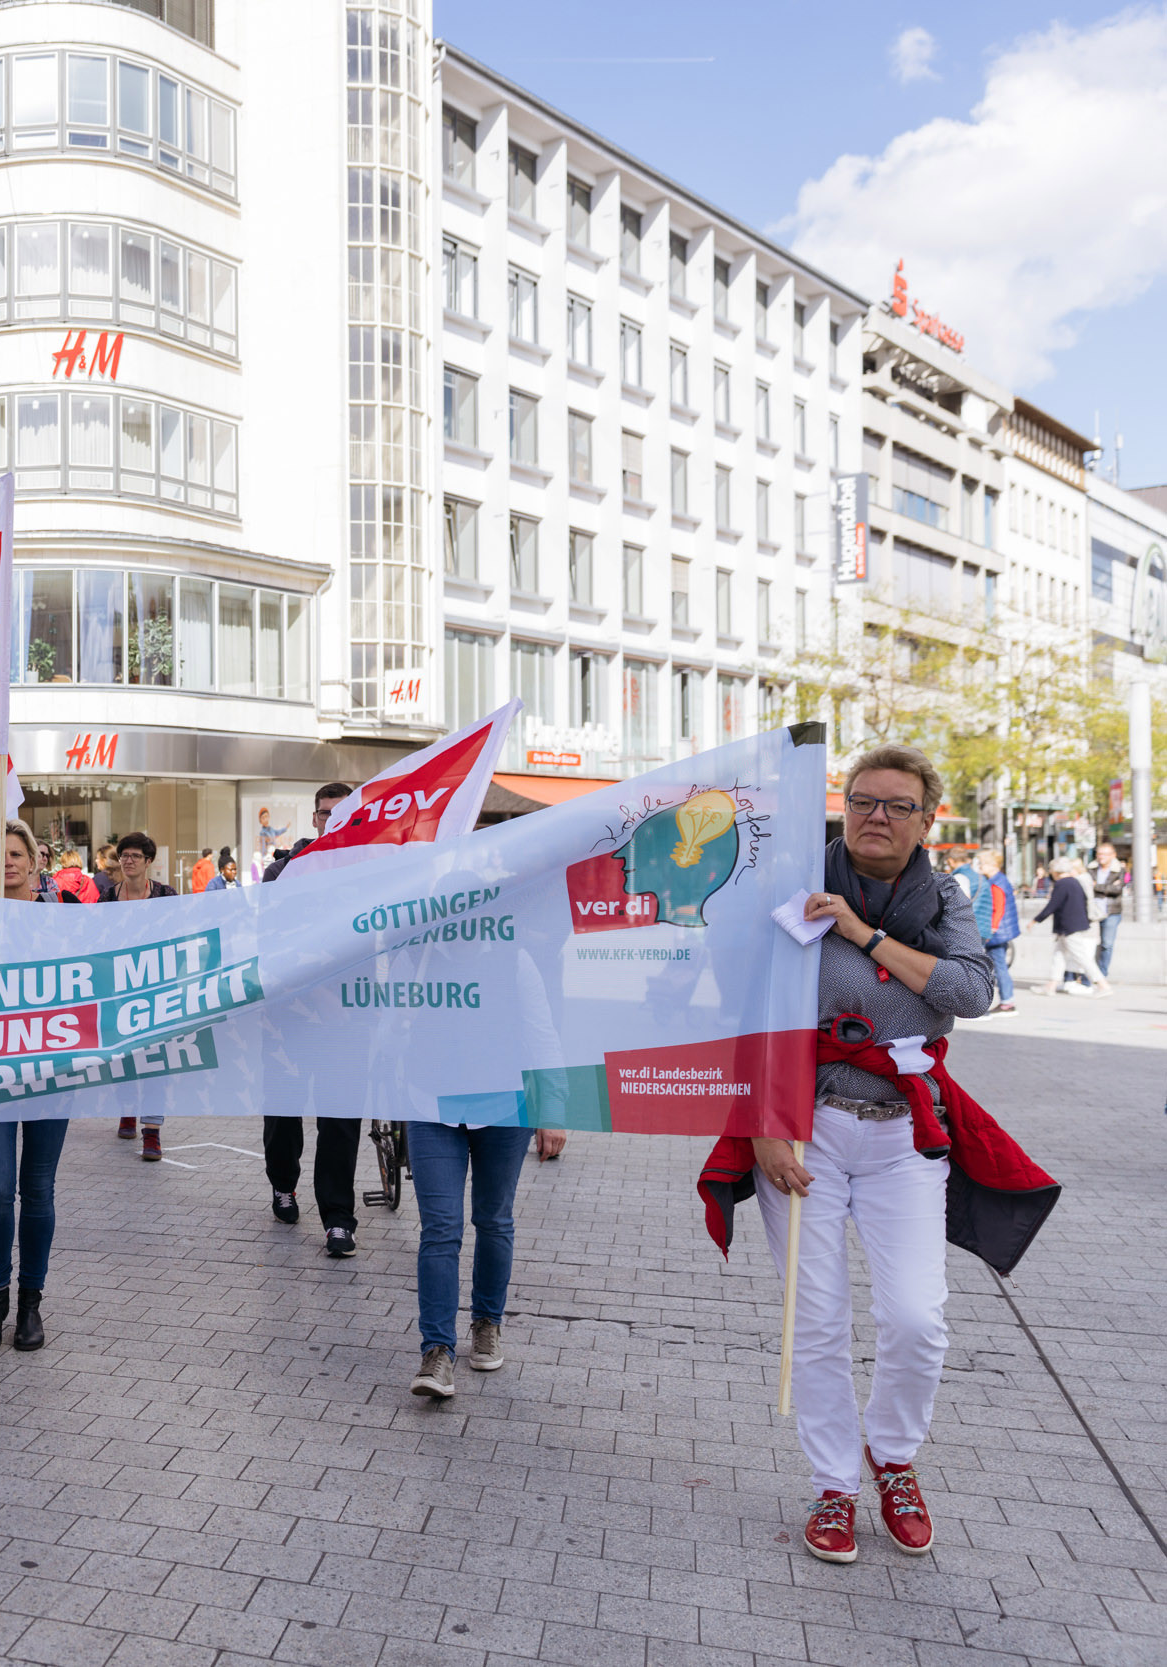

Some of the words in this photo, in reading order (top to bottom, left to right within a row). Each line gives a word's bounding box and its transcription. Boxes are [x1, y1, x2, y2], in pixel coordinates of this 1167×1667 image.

[52, 329, 124, 381] H&M
[389, 678, 421, 704] H&M
[66, 733, 119, 770] H&M
[590, 795, 673, 852] Kohle
[352, 886, 501, 934] GÖTTINGEN
[576, 896, 650, 916] ver.di
[113, 936, 208, 993] MIT
[576, 948, 691, 961] WWW.KFK-VERDI.DE
[116, 961, 253, 1037] GEHT
[341, 976, 481, 1009] LÜNEBURG
[619, 1066, 650, 1079] ver.di
[653, 1067, 723, 1080] Landesbezirk
[621, 1082, 751, 1096] NIEDERSACHSEN-BREMEN
